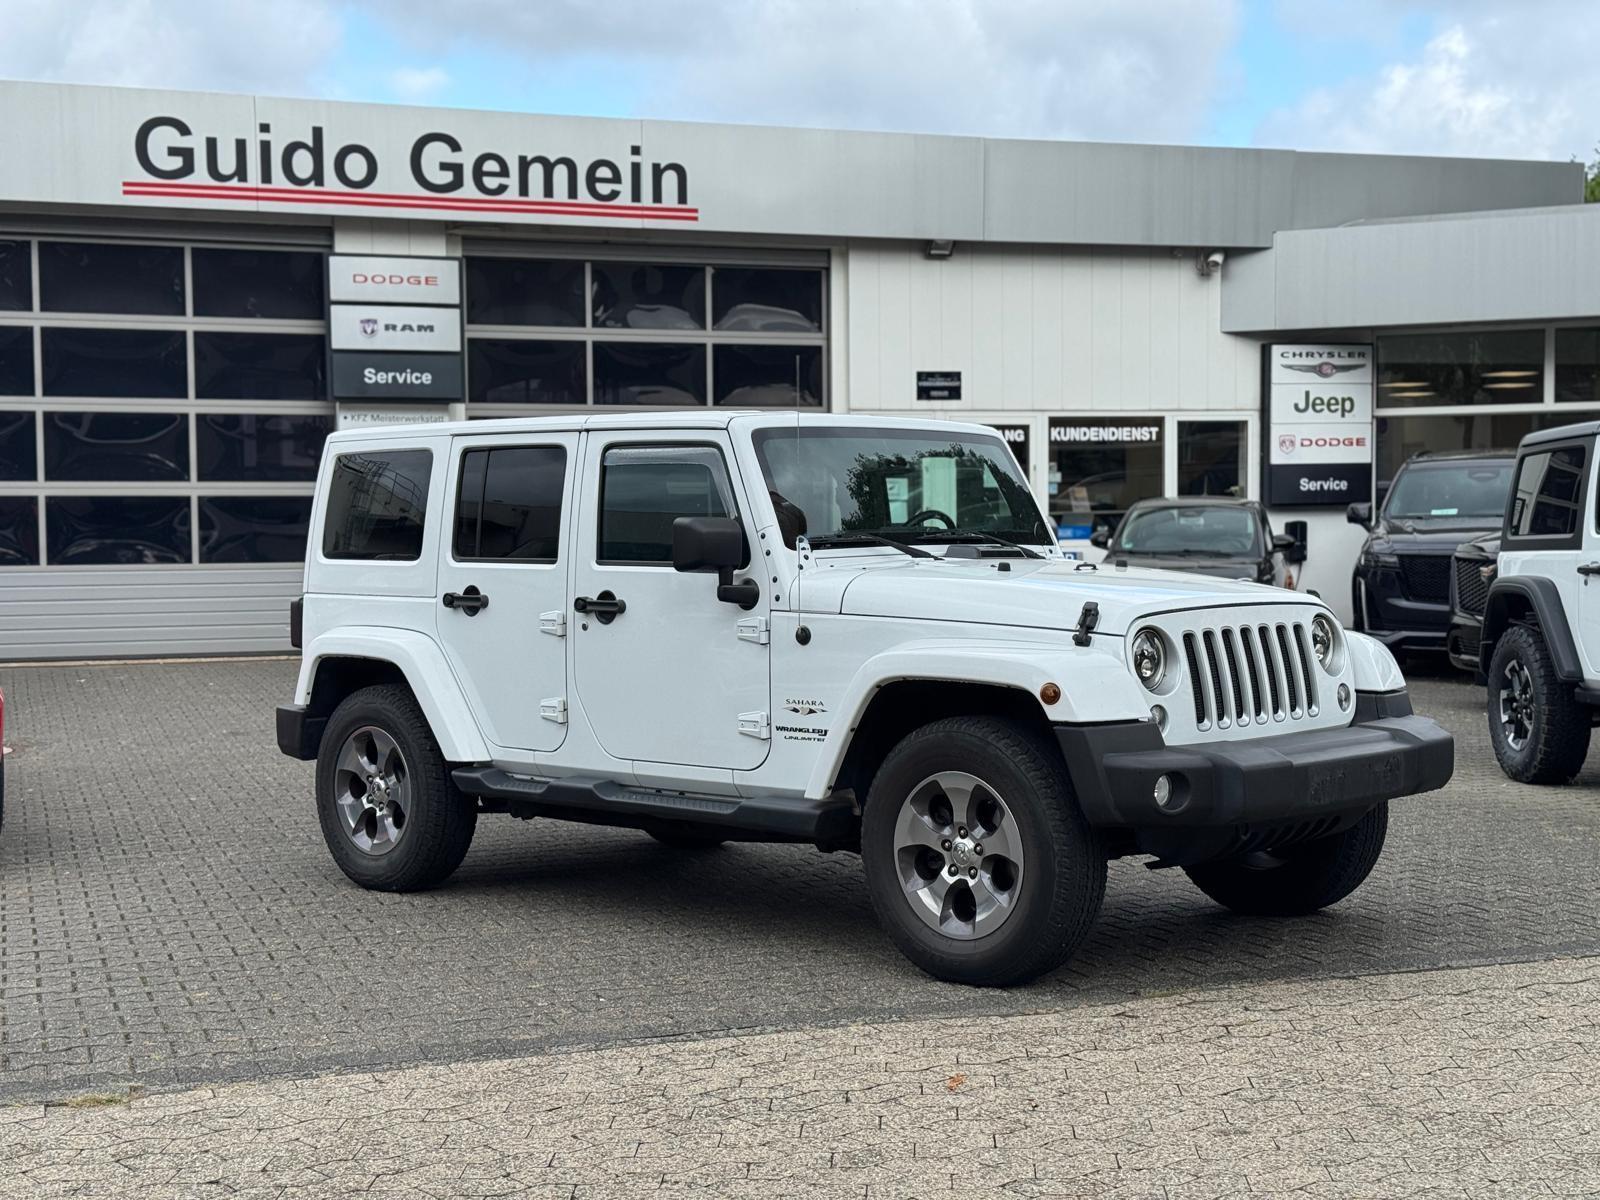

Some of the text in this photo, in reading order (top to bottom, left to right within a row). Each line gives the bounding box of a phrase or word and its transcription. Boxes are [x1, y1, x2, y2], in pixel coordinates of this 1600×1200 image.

[134, 116, 688, 205] Guido Gemein
[352, 273, 438, 286] DODGE
[384, 323, 434, 333] RAM
[1280, 351, 1367, 359] CHRYSLER
[363, 367, 432, 385] Service
[1293, 390, 1355, 418] Jeep
[350, 413, 444, 423] KFZ Meisterwerkstatt
[1050, 427, 1159, 442] KUNDENDIENST
[1300, 437, 1367, 447] DODGE
[1299, 477, 1348, 491] Service
[785, 698, 824, 706] SAHARA
